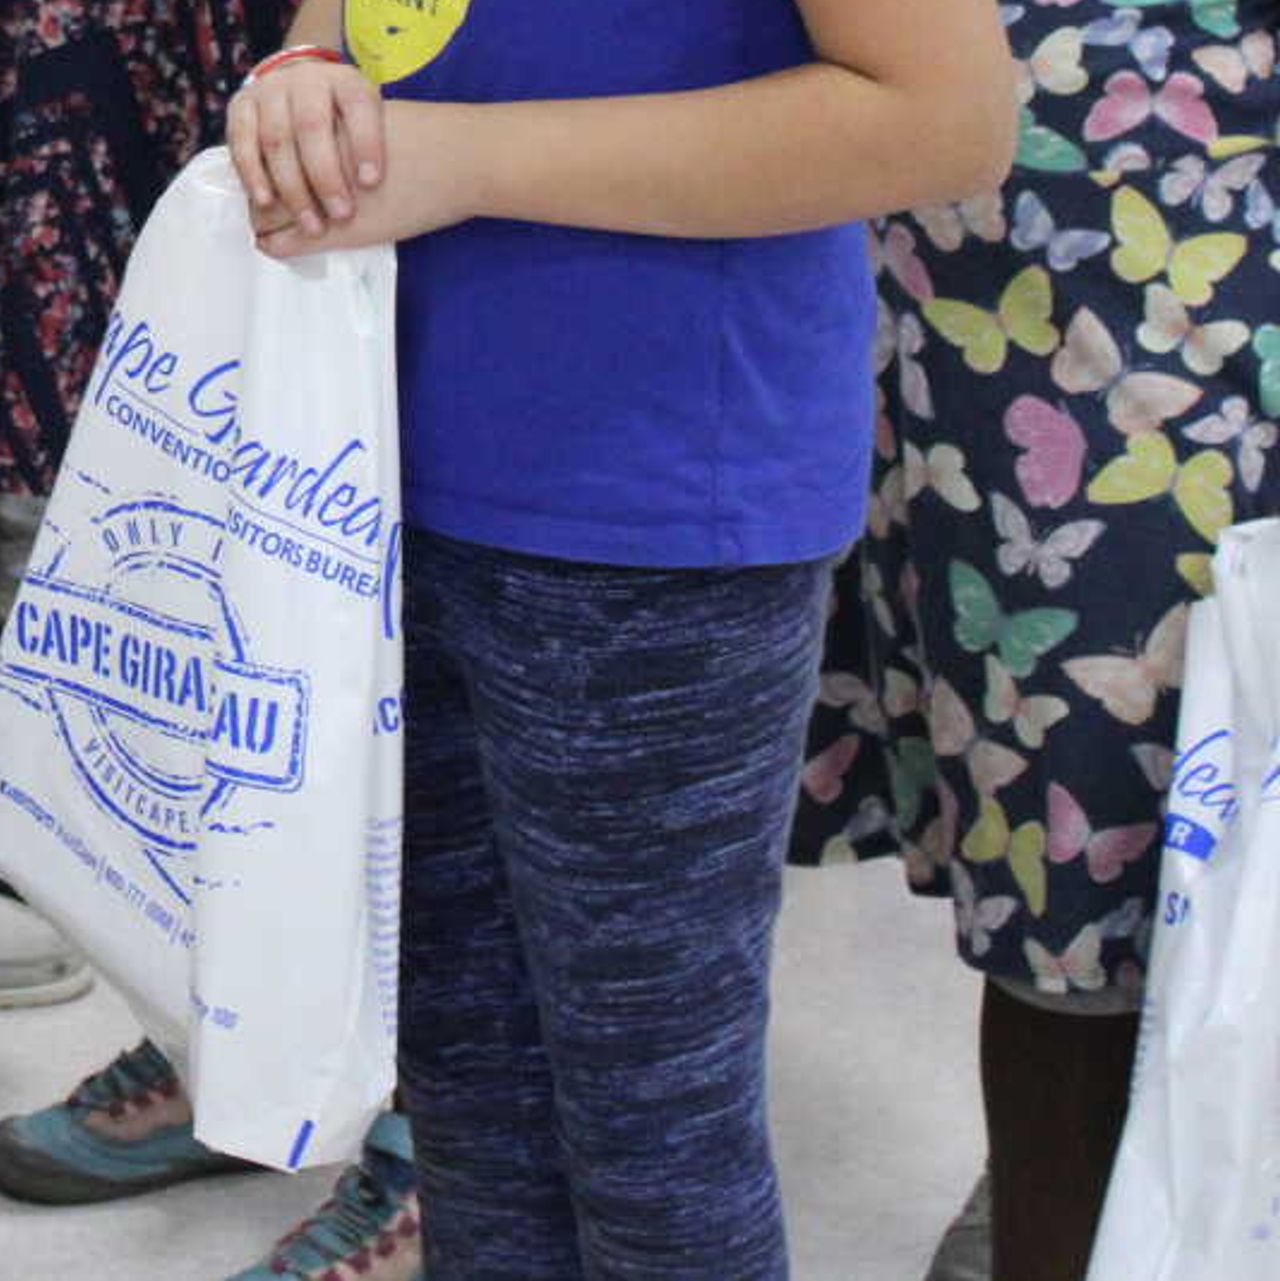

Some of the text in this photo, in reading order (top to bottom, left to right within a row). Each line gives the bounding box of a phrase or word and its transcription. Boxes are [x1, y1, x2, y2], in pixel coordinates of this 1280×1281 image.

[105, 394, 232, 484] CONVENTIO
[227, 504, 303, 568] SITORS
[16, 600, 112, 678] CAPE
[119, 633, 279, 754] GIRAAU
